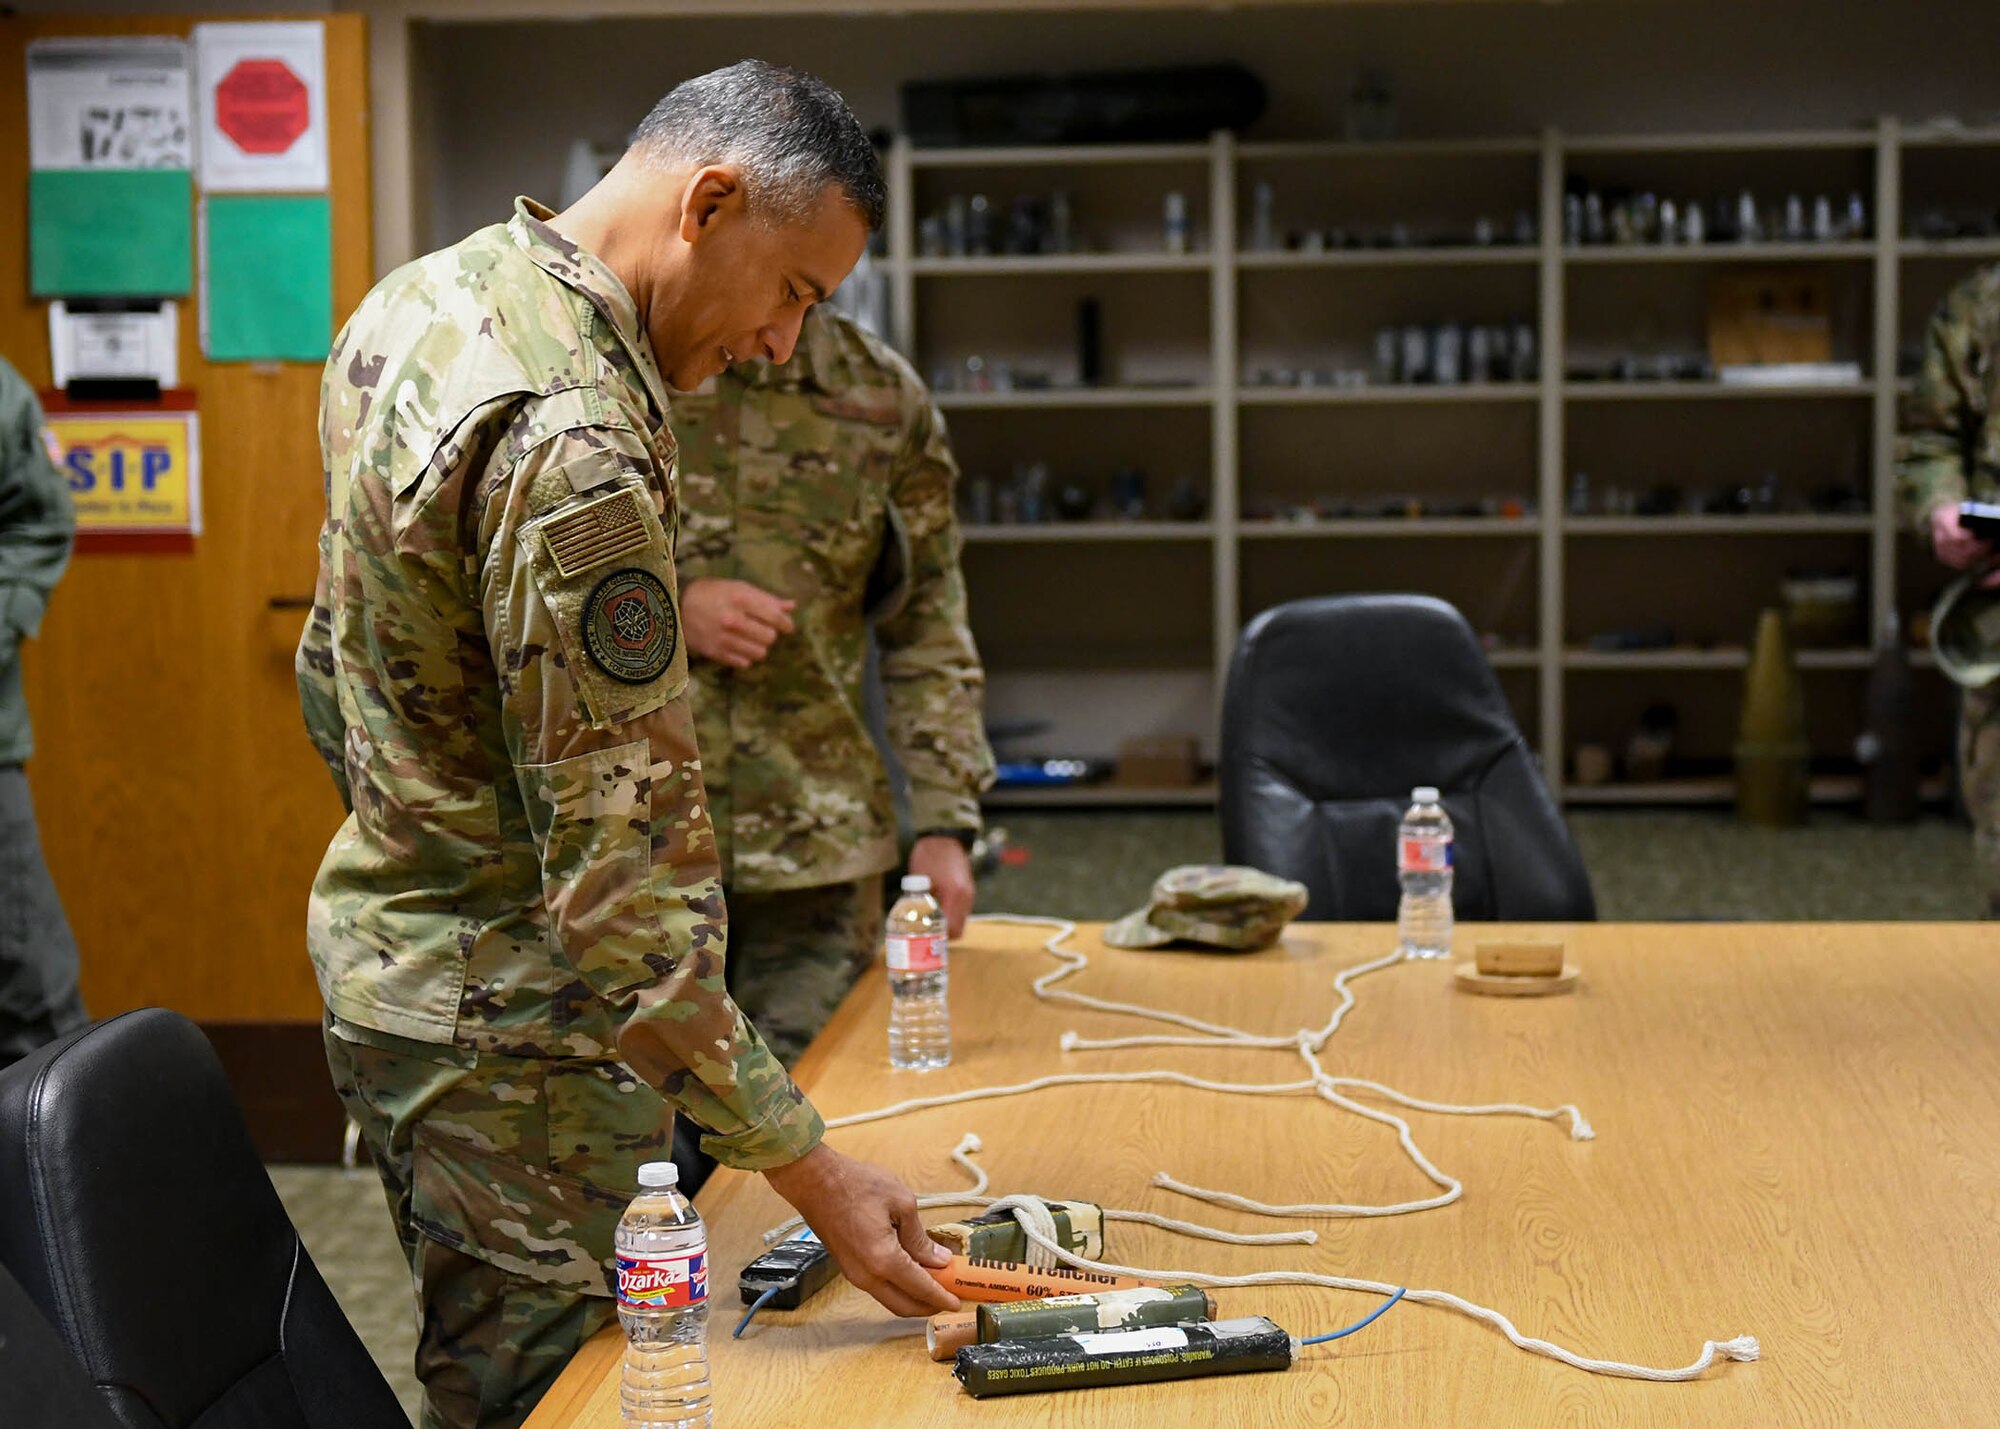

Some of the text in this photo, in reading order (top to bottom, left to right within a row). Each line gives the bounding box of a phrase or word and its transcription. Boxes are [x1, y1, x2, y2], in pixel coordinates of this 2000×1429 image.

[607, 661, 624, 675] FOR
[616, 1267, 679, 1291] Ozarka
[987, 1282, 1021, 1294] AMMONIA
[1026, 1284, 1055, 1298] 60%
[1086, 1361, 1100, 1371] NOT
[1135, 1357, 1141, 1367] IF
[1141, 1353, 1179, 1367] POISONOUS
[987, 1369, 1009, 1380] GASES
[1009, 1368, 1029, 1378] TOXIC
